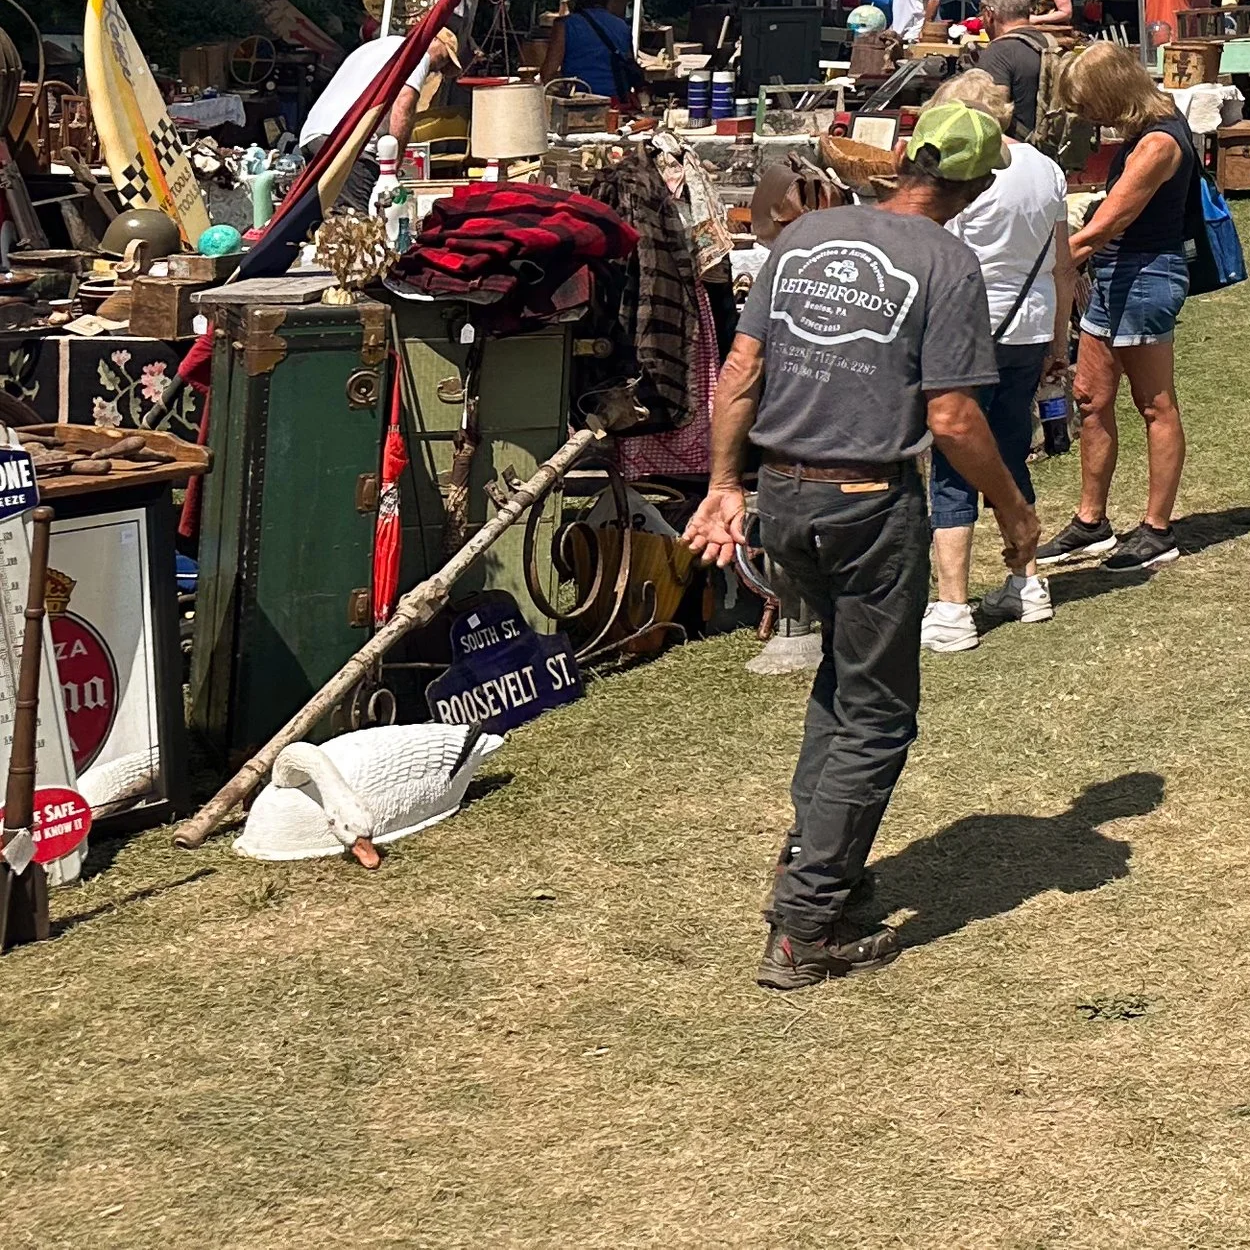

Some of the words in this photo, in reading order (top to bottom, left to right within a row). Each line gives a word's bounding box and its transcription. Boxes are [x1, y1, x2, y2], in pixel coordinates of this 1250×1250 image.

[779, 277, 898, 318] RETHERFORD'S
[835, 305, 847, 317] PA
[800, 316, 823, 331] SINCE
[460, 626, 500, 653] SOUTH
[501, 619, 520, 639] ST.
[436, 666, 538, 725] ROOSEVELT
[546, 653, 575, 691] ST.
[44, 821, 72, 840] KNOW
[74, 818, 83, 831] IT
